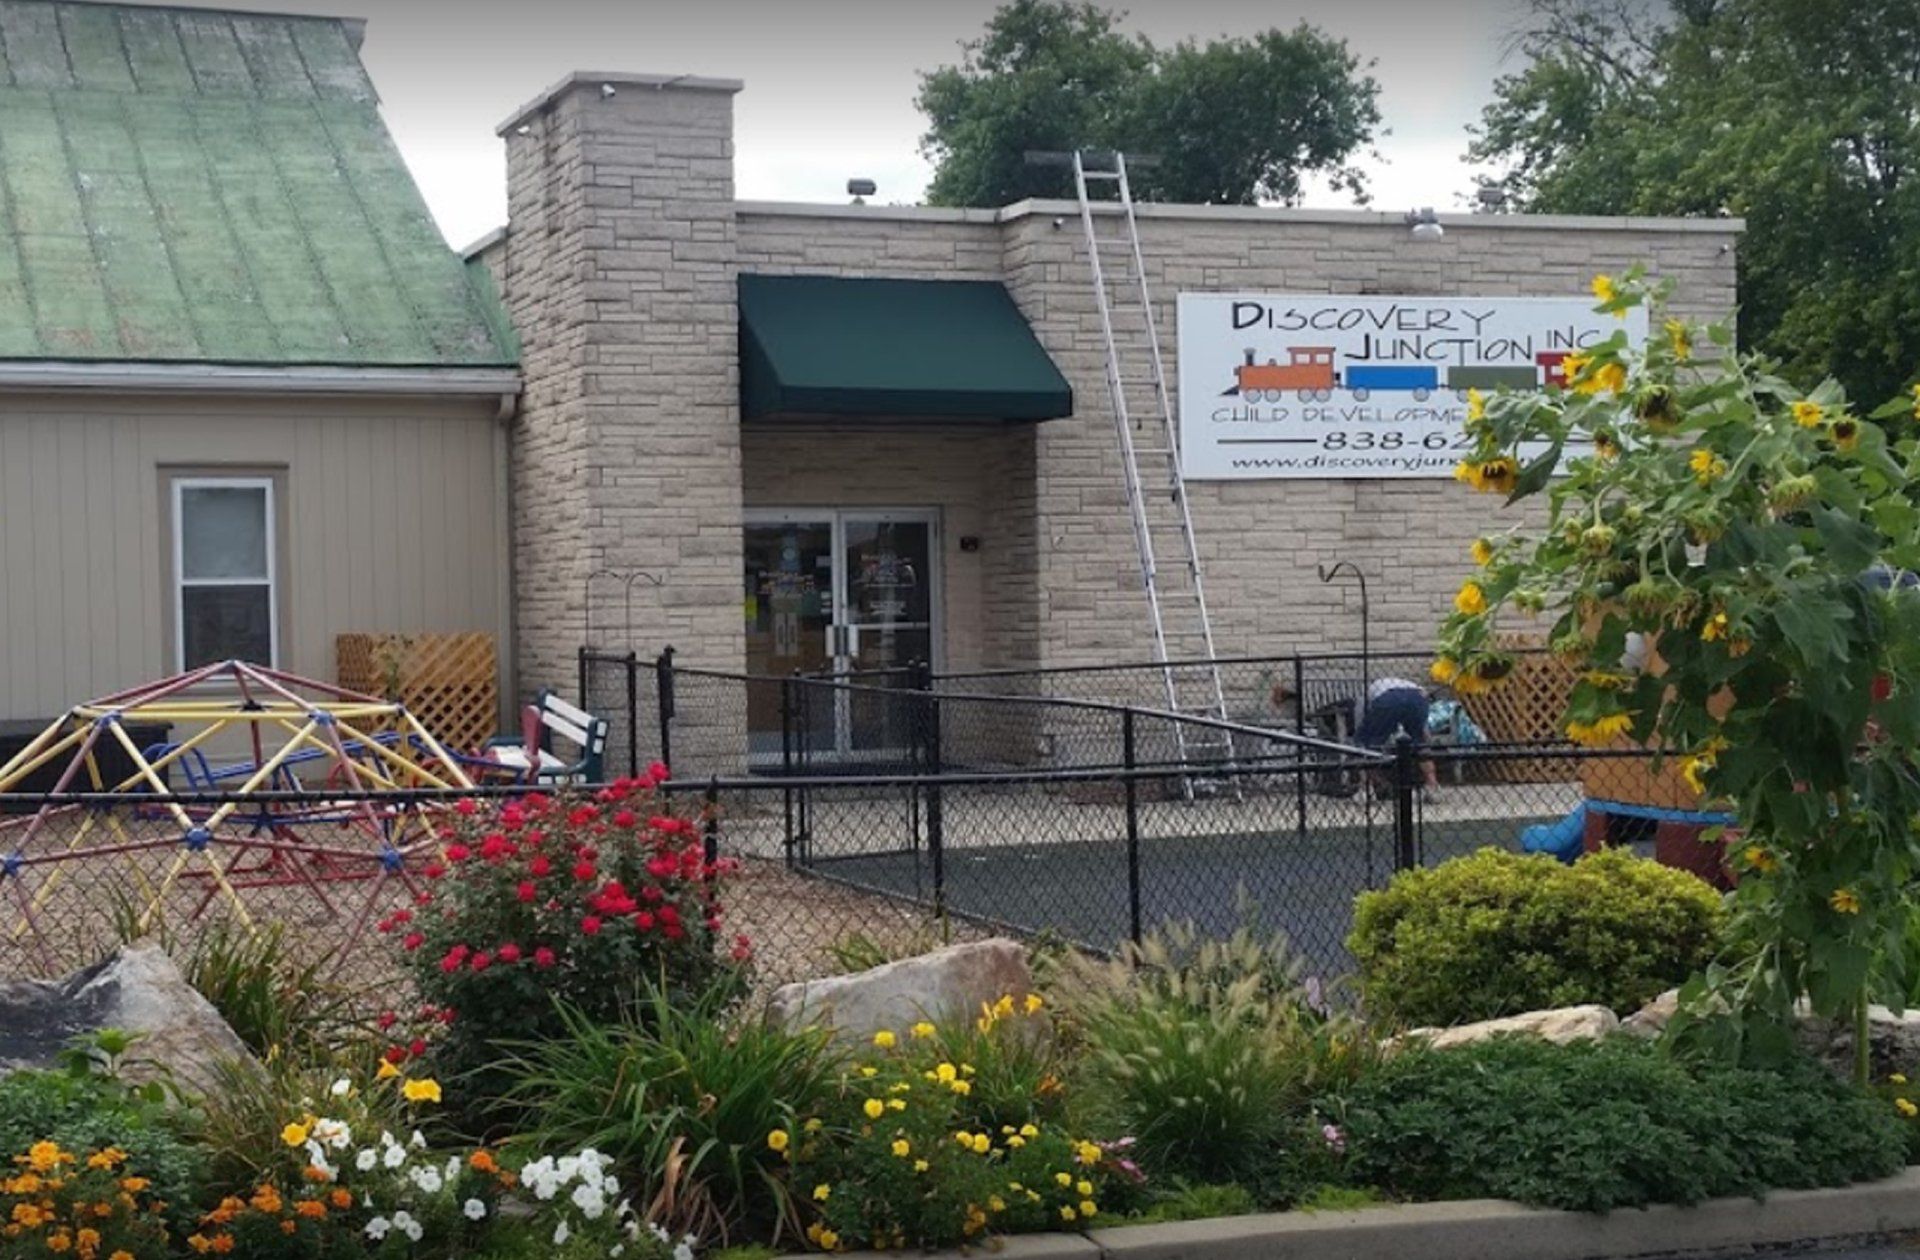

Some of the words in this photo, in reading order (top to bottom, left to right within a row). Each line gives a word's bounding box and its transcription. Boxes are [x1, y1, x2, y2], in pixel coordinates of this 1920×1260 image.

[1232, 302, 1495, 336] DISCOVERY
[1343, 333, 1531, 366] JUNCTION
[1211, 405, 1289, 423] CHILD
[1302, 405, 1466, 425] DEVELOPME
[1322, 431, 1476, 451] 838-62
[1232, 454, 1459, 472] www.discoveryjun
